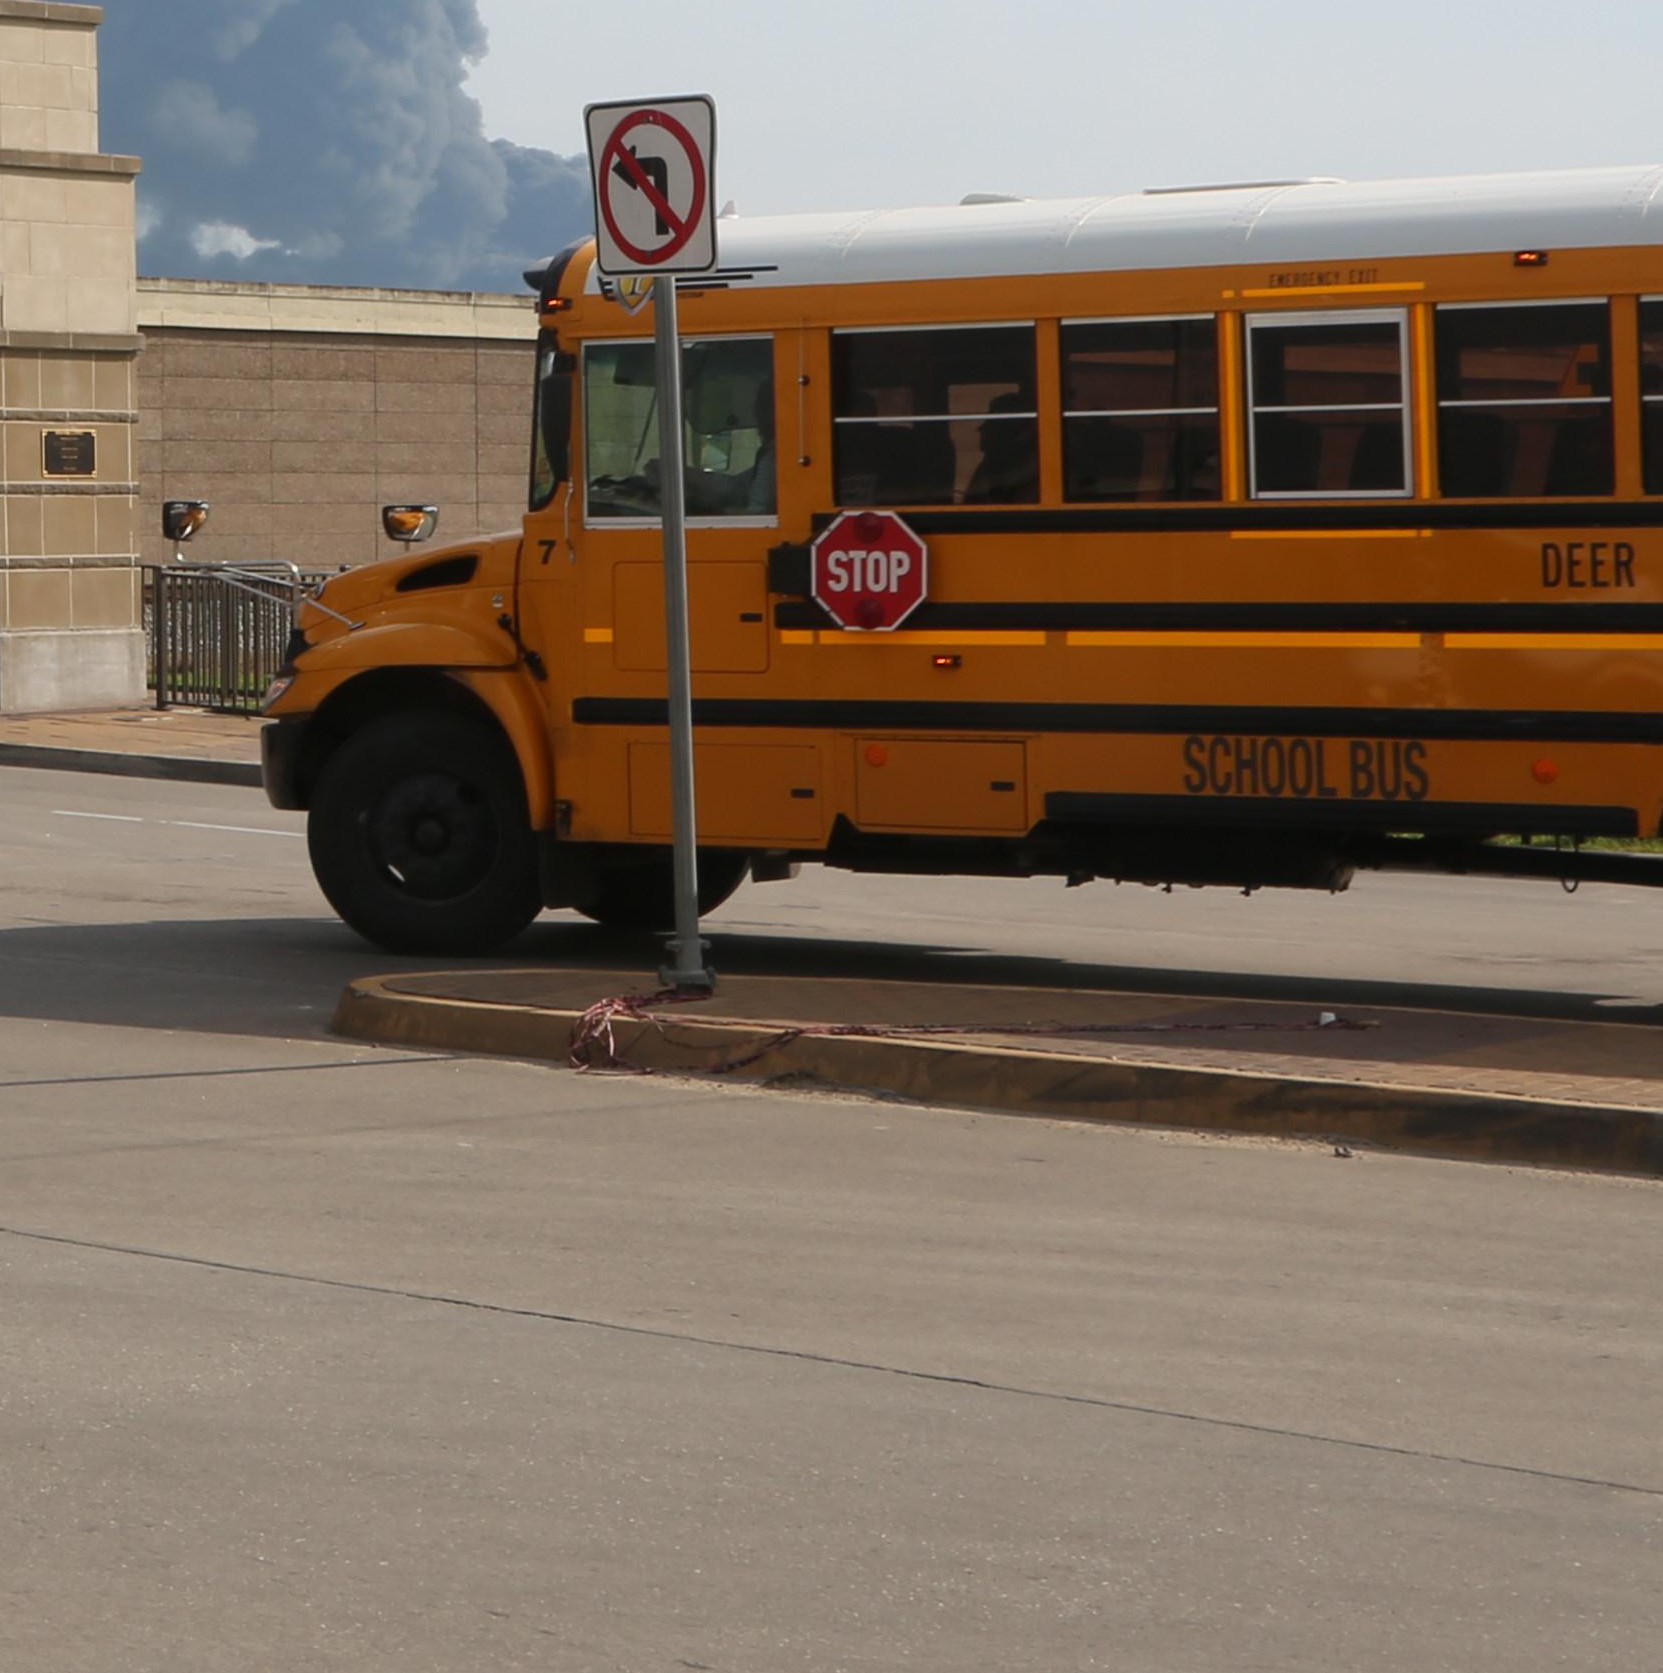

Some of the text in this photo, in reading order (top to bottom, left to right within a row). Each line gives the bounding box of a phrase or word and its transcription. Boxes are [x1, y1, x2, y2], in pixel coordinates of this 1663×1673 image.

[538, 539, 557, 565] 7
[827, 550, 911, 593] STOP
[1541, 542, 1636, 587] DEER
[1183, 736, 1429, 800] SCHOOL BUS
